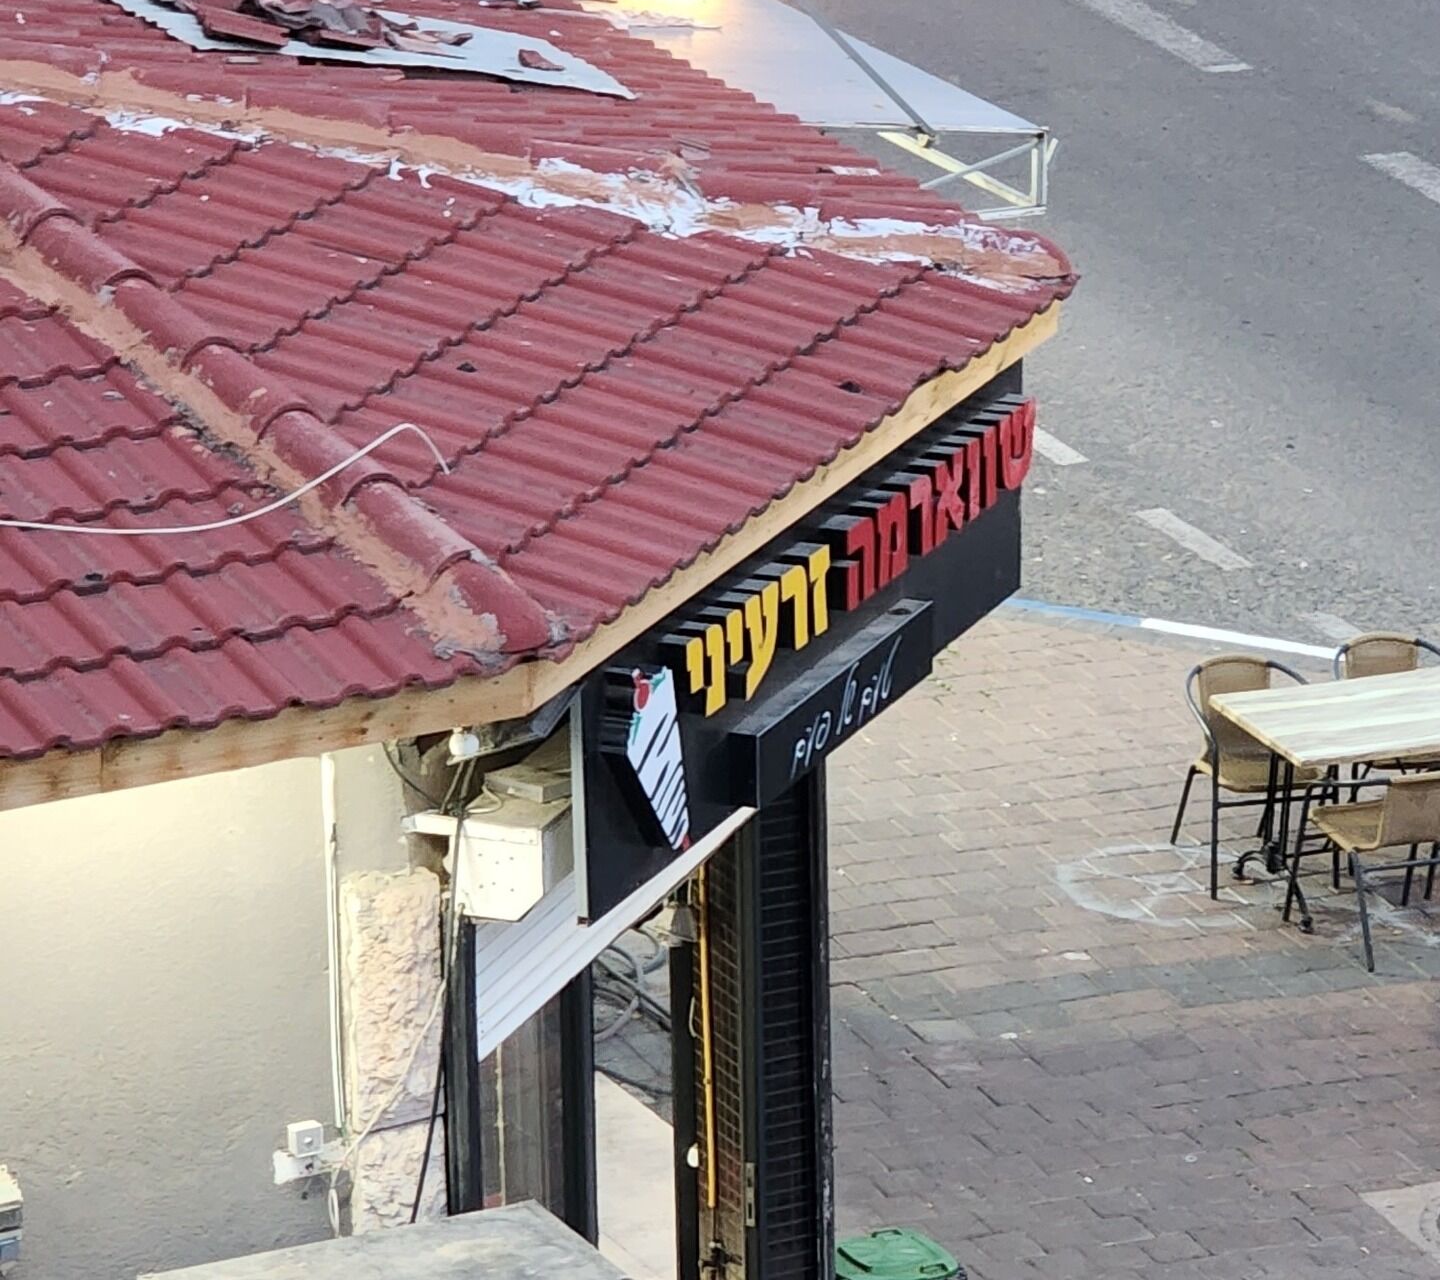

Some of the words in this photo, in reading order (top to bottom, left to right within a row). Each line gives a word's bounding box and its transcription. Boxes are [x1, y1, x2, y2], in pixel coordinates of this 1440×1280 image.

[845, 396, 1036, 612] שווארמה
[685, 543, 831, 718] זרעיני
[789, 710, 833, 782] פעם
